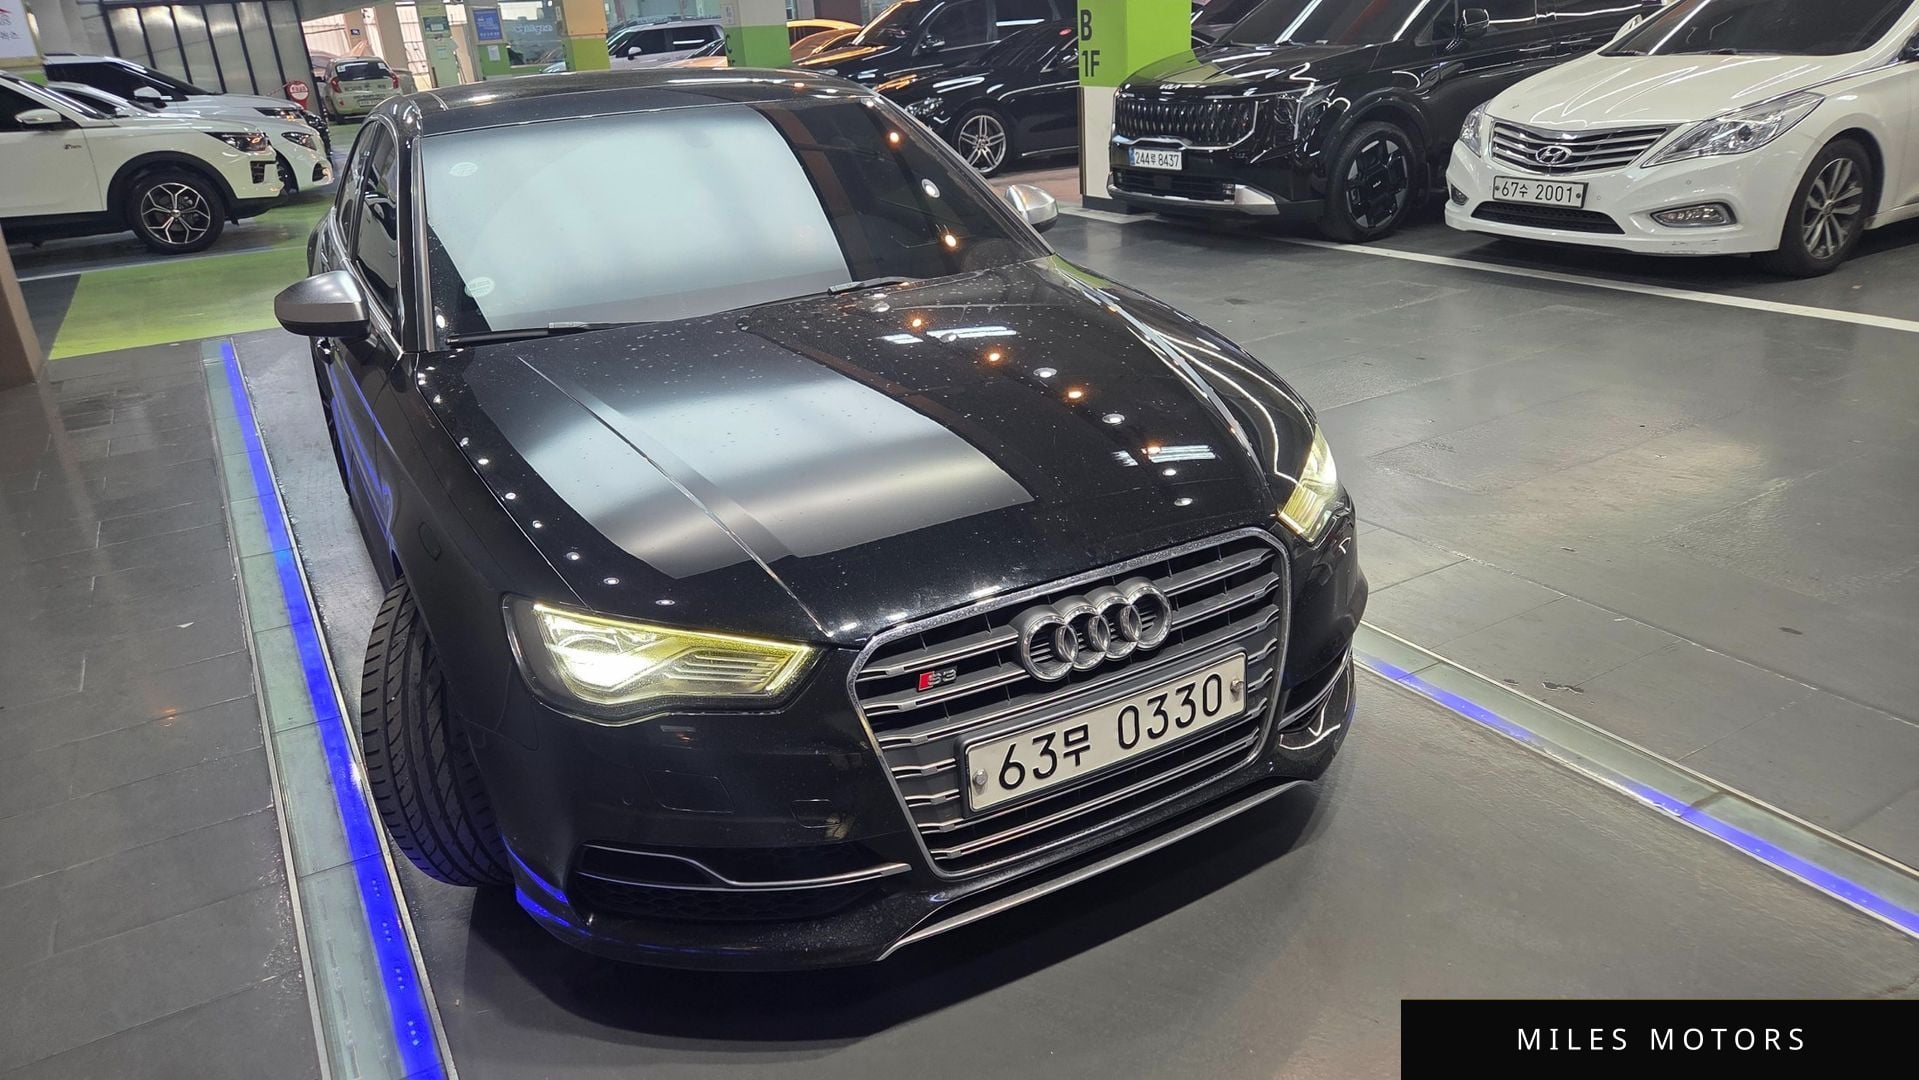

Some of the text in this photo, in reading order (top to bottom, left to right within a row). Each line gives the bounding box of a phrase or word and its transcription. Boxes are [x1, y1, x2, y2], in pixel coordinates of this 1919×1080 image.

[1080, 9, 1093, 41] B
[725, 34, 733, 54] C
[1082, 50, 1100, 77] 1F
[1158, 153, 1179, 167] 8437
[1501, 181, 1573, 203] 67수 2001
[926, 668, 957, 687] S3
[998, 673, 1222, 790] 63무 0330
